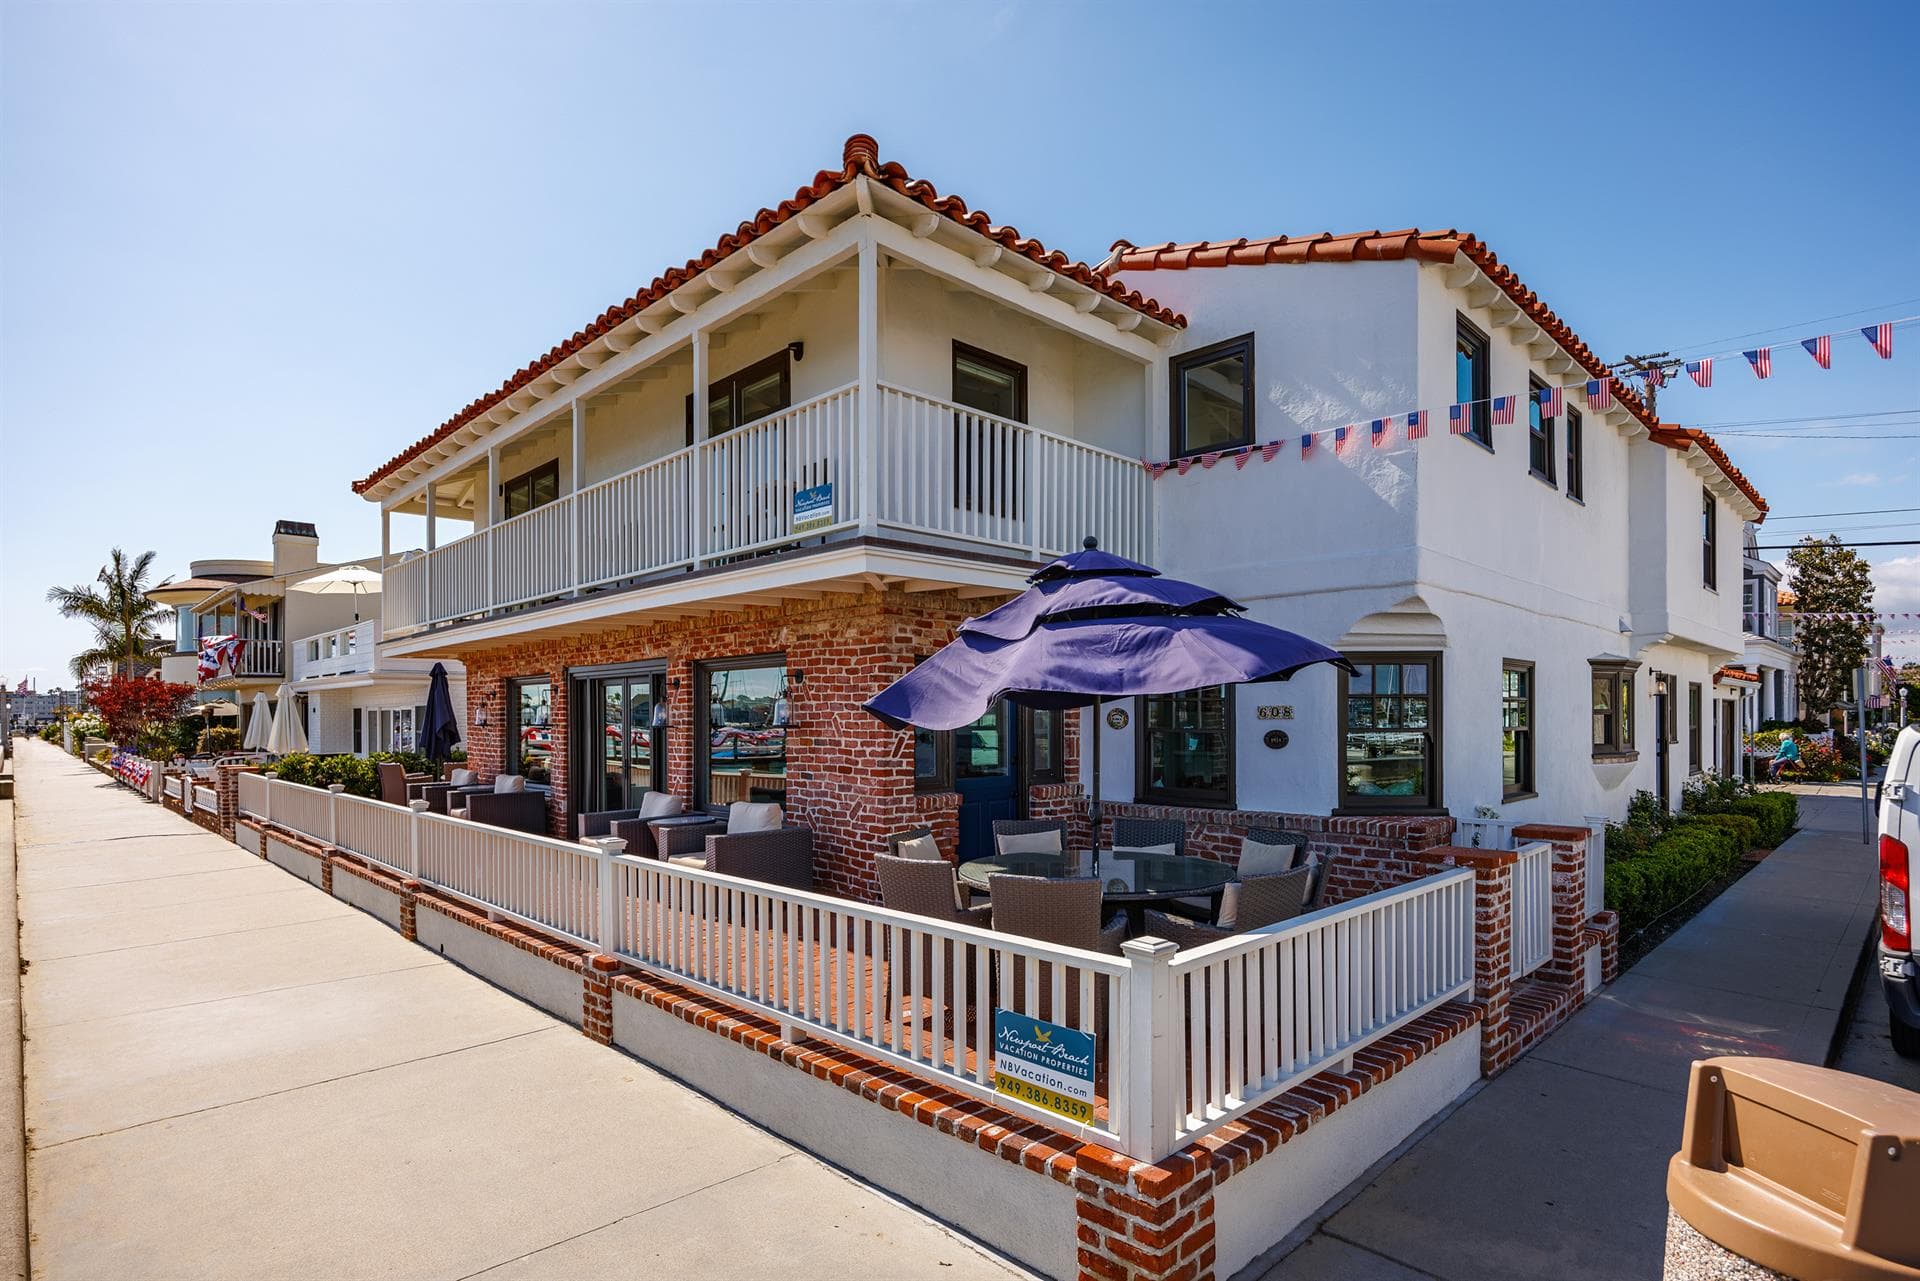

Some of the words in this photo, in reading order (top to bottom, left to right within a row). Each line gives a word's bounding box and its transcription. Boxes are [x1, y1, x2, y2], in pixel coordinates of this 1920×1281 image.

[1259, 706, 1291, 717] 608
[998, 1025, 1049, 1053] Newport
[1050, 1043, 1090, 1066] Beach
[1000, 1042, 1038, 1061] VACATION
[1041, 1055, 1088, 1077] PROPERTIES
[999, 1077, 1087, 1118] 949.386.8359
[1000, 1059, 1087, 1098] NBVacation.com
